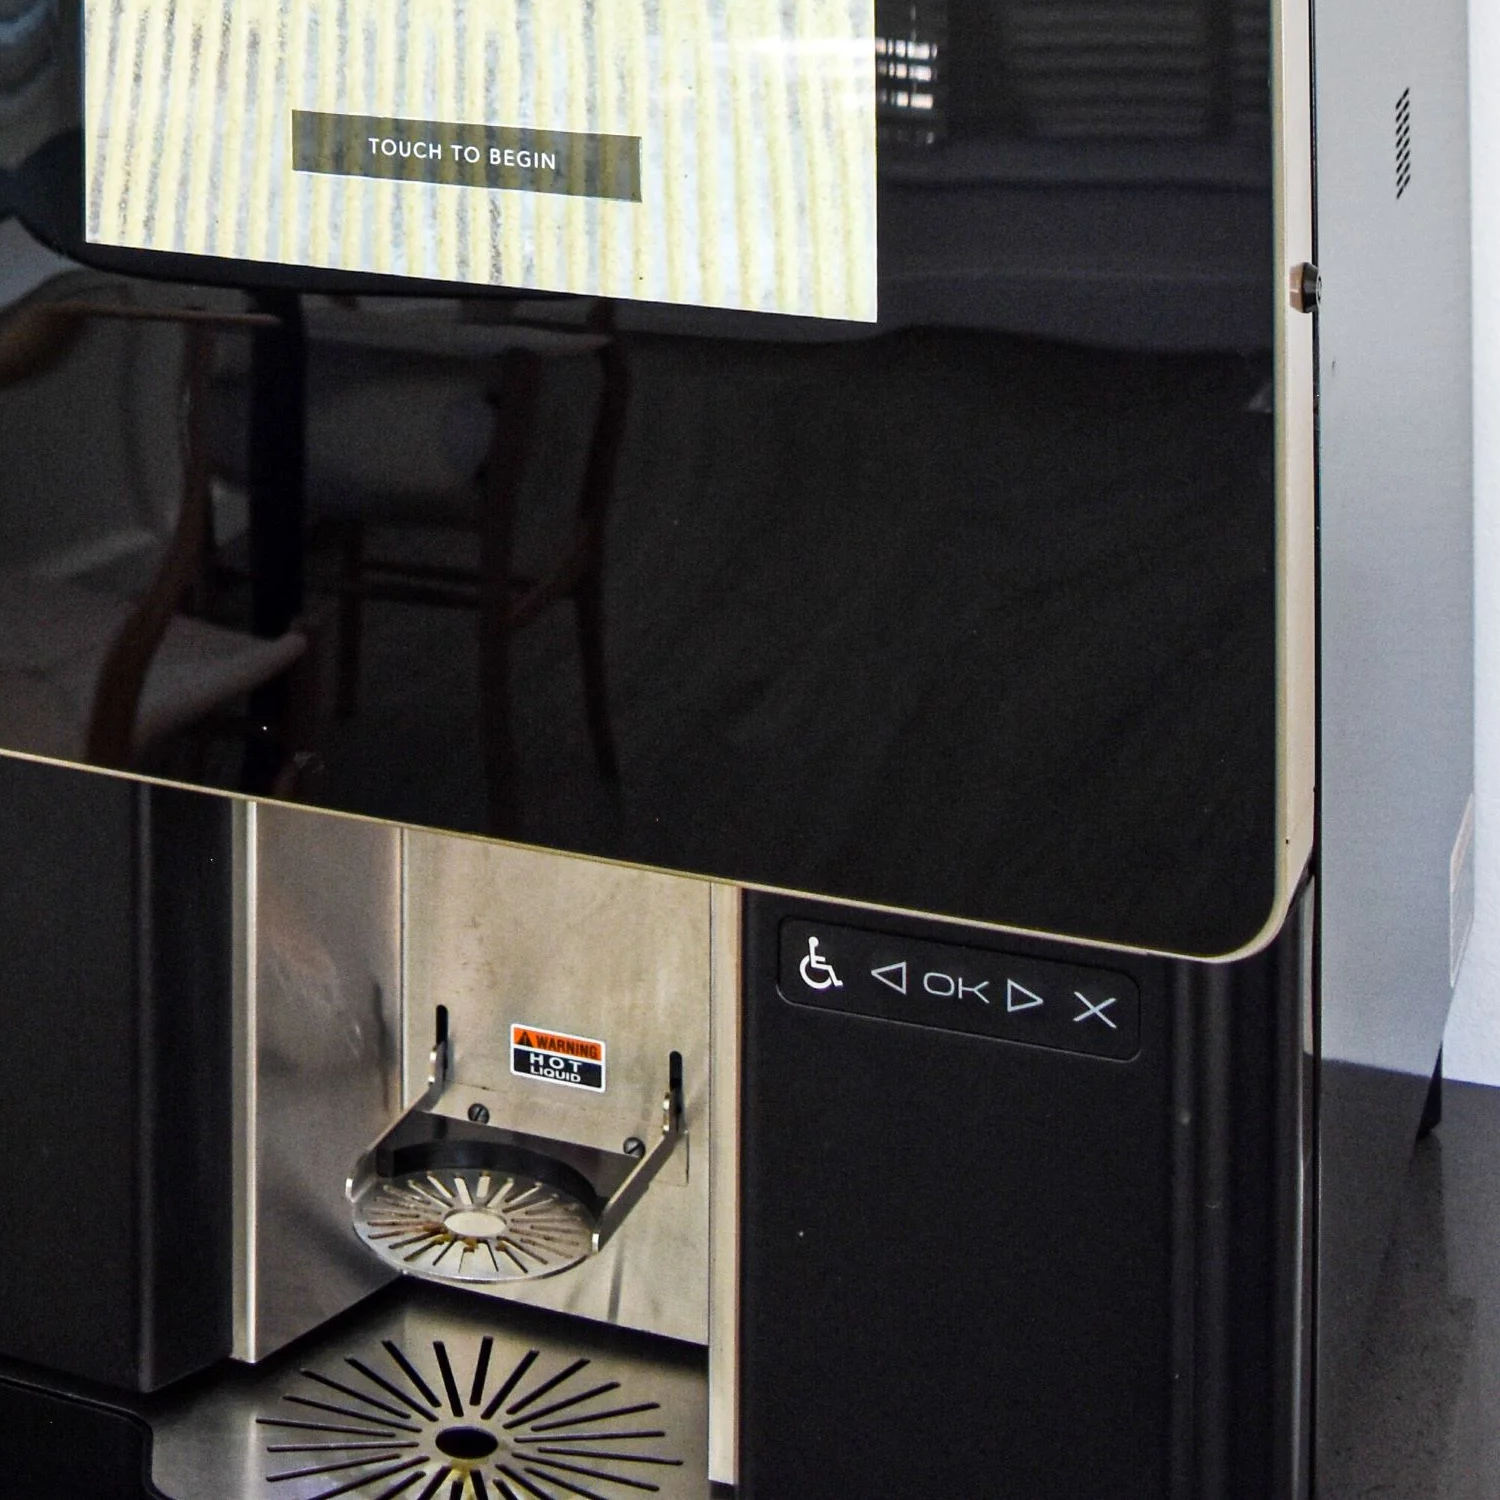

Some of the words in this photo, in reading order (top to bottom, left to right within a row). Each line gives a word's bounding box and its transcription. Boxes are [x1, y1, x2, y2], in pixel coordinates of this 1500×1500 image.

[368, 137, 442, 160] TOUCH
[451, 145, 480, 163] TO
[489, 148, 557, 170] BEGIN
[923, 971, 990, 1004] OK
[536, 1035, 598, 1058] WARNING
[529, 1052, 583, 1073] HOT
[530, 1065, 581, 1083] LIQUID
